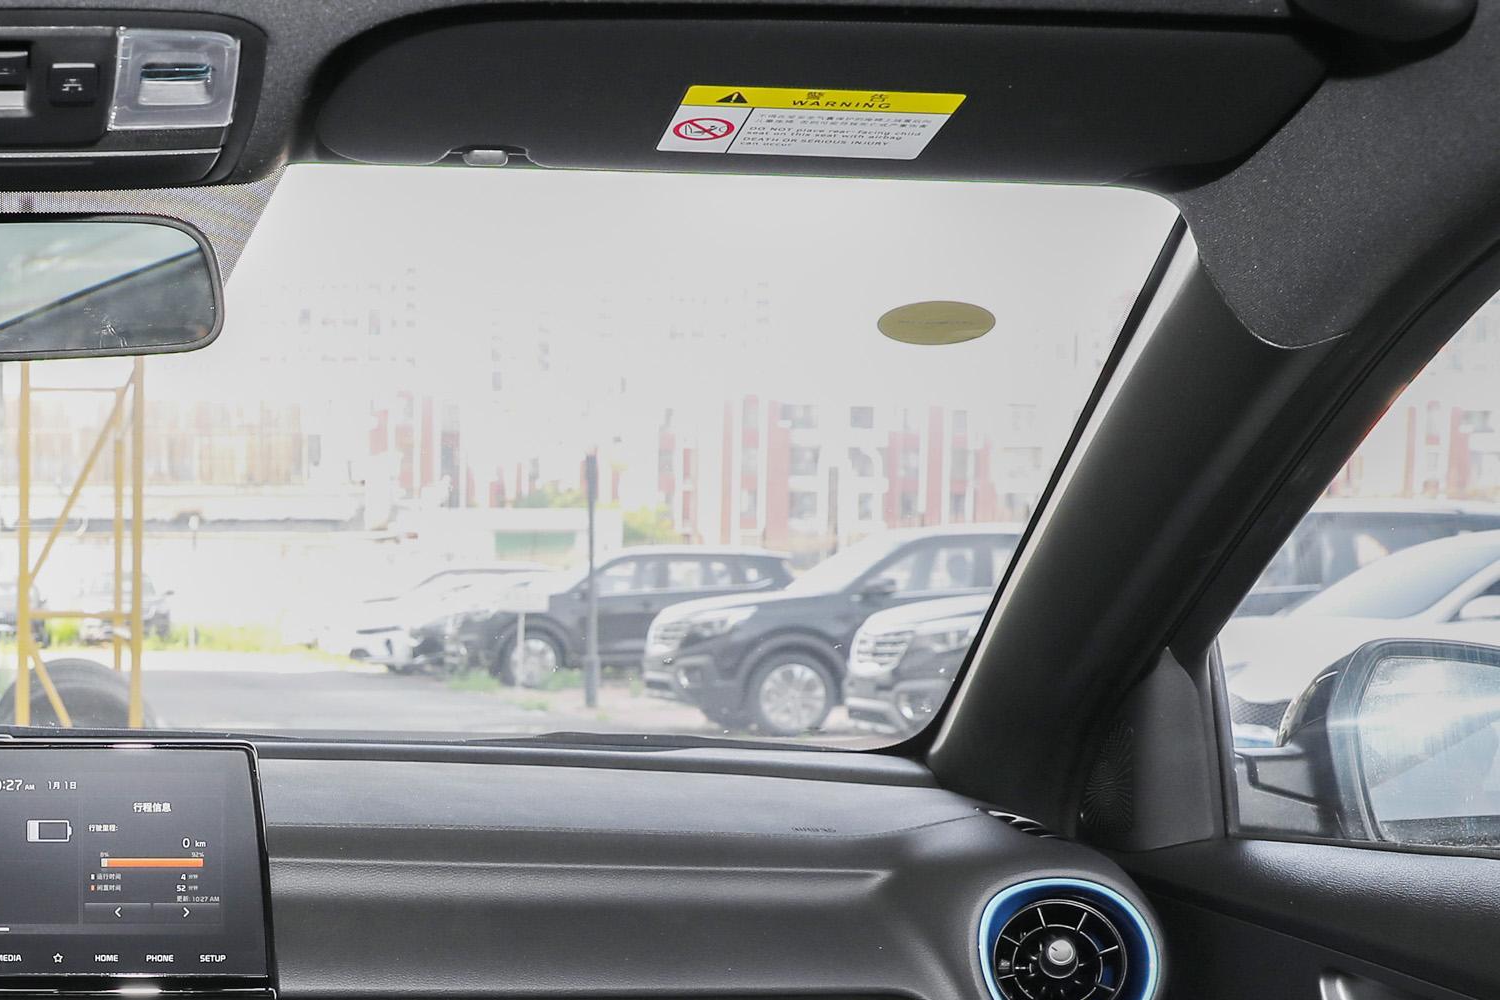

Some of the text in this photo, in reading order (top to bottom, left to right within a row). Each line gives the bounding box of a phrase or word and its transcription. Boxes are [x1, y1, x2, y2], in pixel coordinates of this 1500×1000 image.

[792, 100, 890, 109] WARNING
[133, 802, 172, 813] 行程信息
[182, 838, 206, 848] 0 km
[180, 873, 187, 881] 4
[94, 954, 119, 962] HOME
[146, 954, 174, 962] PHONE
[199, 954, 226, 962] SETUP
